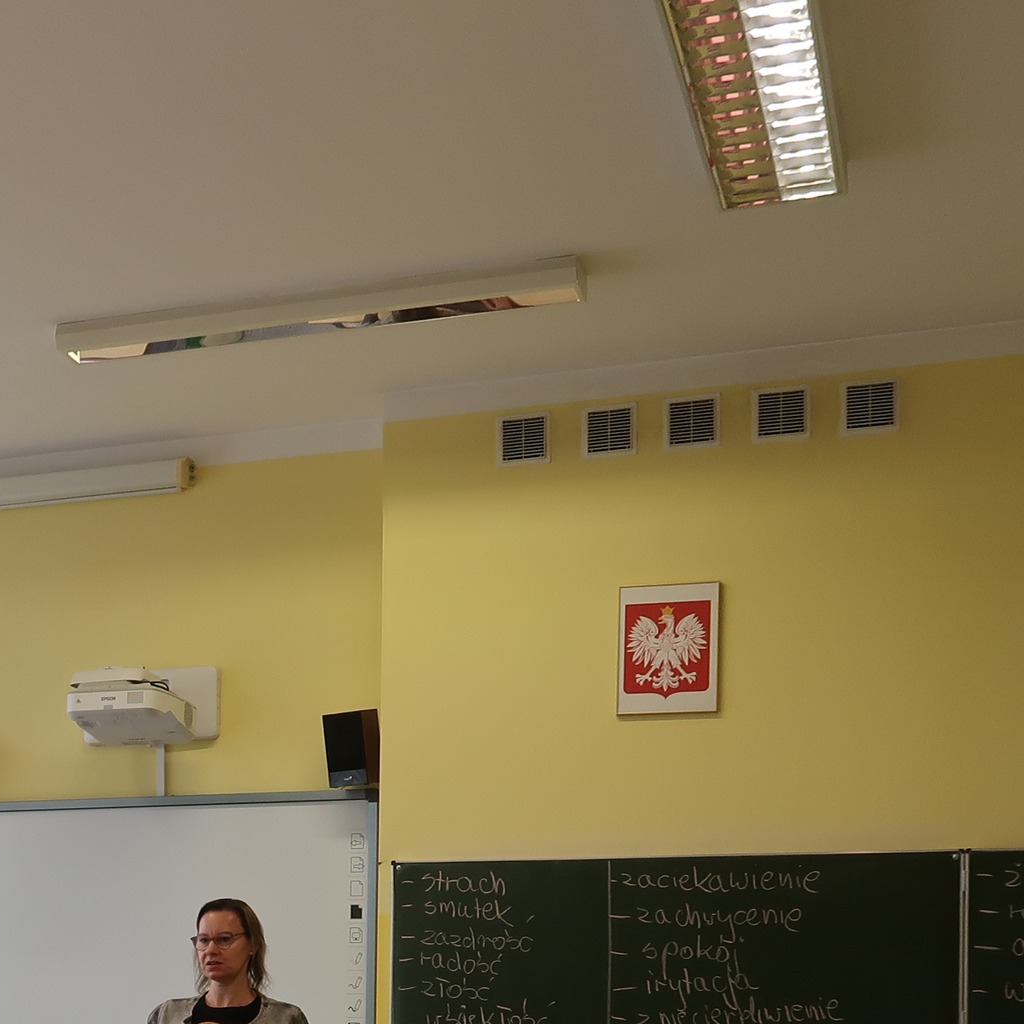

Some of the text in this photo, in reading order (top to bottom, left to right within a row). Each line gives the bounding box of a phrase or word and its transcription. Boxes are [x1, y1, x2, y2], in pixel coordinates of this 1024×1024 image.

[421, 870, 506, 896] strach
[621, 866, 821, 894] zaciekawienie
[424, 898, 514, 928] smutek
[636, 902, 803, 944] zachwycenie
[420, 915, 535, 953] zazdrość
[420, 951, 504, 976] radość
[641, 934, 745, 981] spokój
[420, 976, 495, 1002] złość
[645, 967, 760, 1011] irytacja
